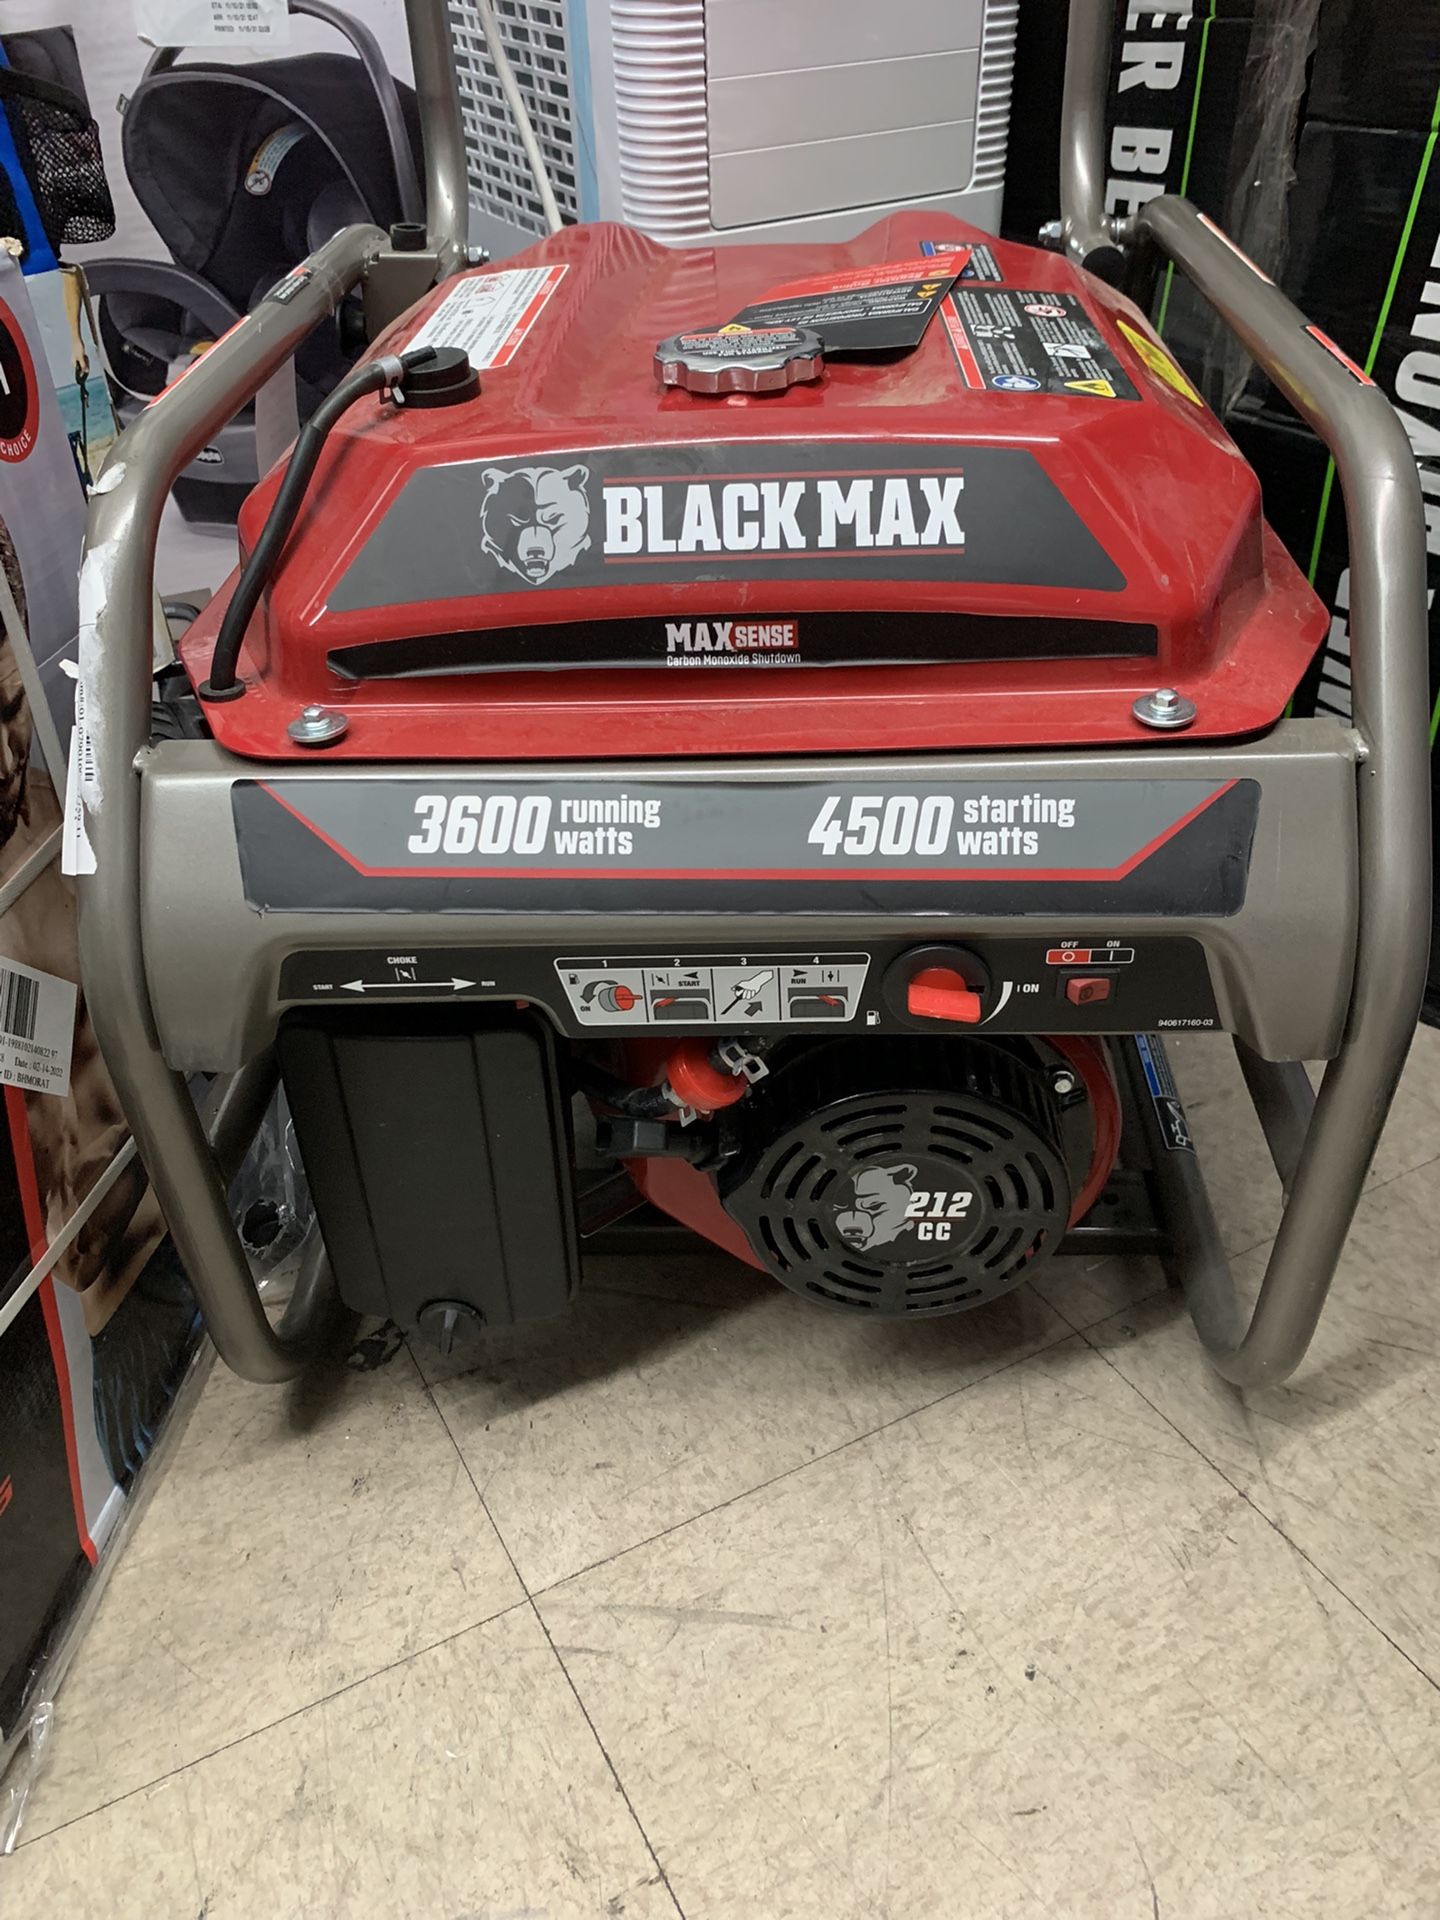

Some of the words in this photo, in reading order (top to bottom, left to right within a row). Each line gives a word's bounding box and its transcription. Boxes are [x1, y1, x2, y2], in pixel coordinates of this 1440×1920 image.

[0, 429, 31, 456] CHOICE
[602, 480, 806, 556] BLACK
[817, 476, 965, 548] MAX
[665, 622, 736, 652] MAX
[735, 625, 794, 648] SENSE
[667, 655, 701, 667] Carbon
[703, 653, 750, 666] Monoxide
[752, 652, 801, 665] Shutdown
[408, 795, 552, 854] 3600
[560, 794, 662, 828] running
[808, 796, 955, 855] 4500
[963, 793, 1076, 828] starting
[554, 827, 633, 855] watts
[957, 827, 1039, 855] watts
[1060, 941, 1079, 949] OFF
[1106, 940, 1121, 948] ON
[387, 956, 418, 964] CHOKE
[673, 958, 681, 967] 2
[740, 957, 748, 965] 3
[813, 956, 820, 964] 4
[1022, 983, 1040, 993] ON
[904, 1191, 973, 1218] 212
[917, 1222, 951, 1241] CC
